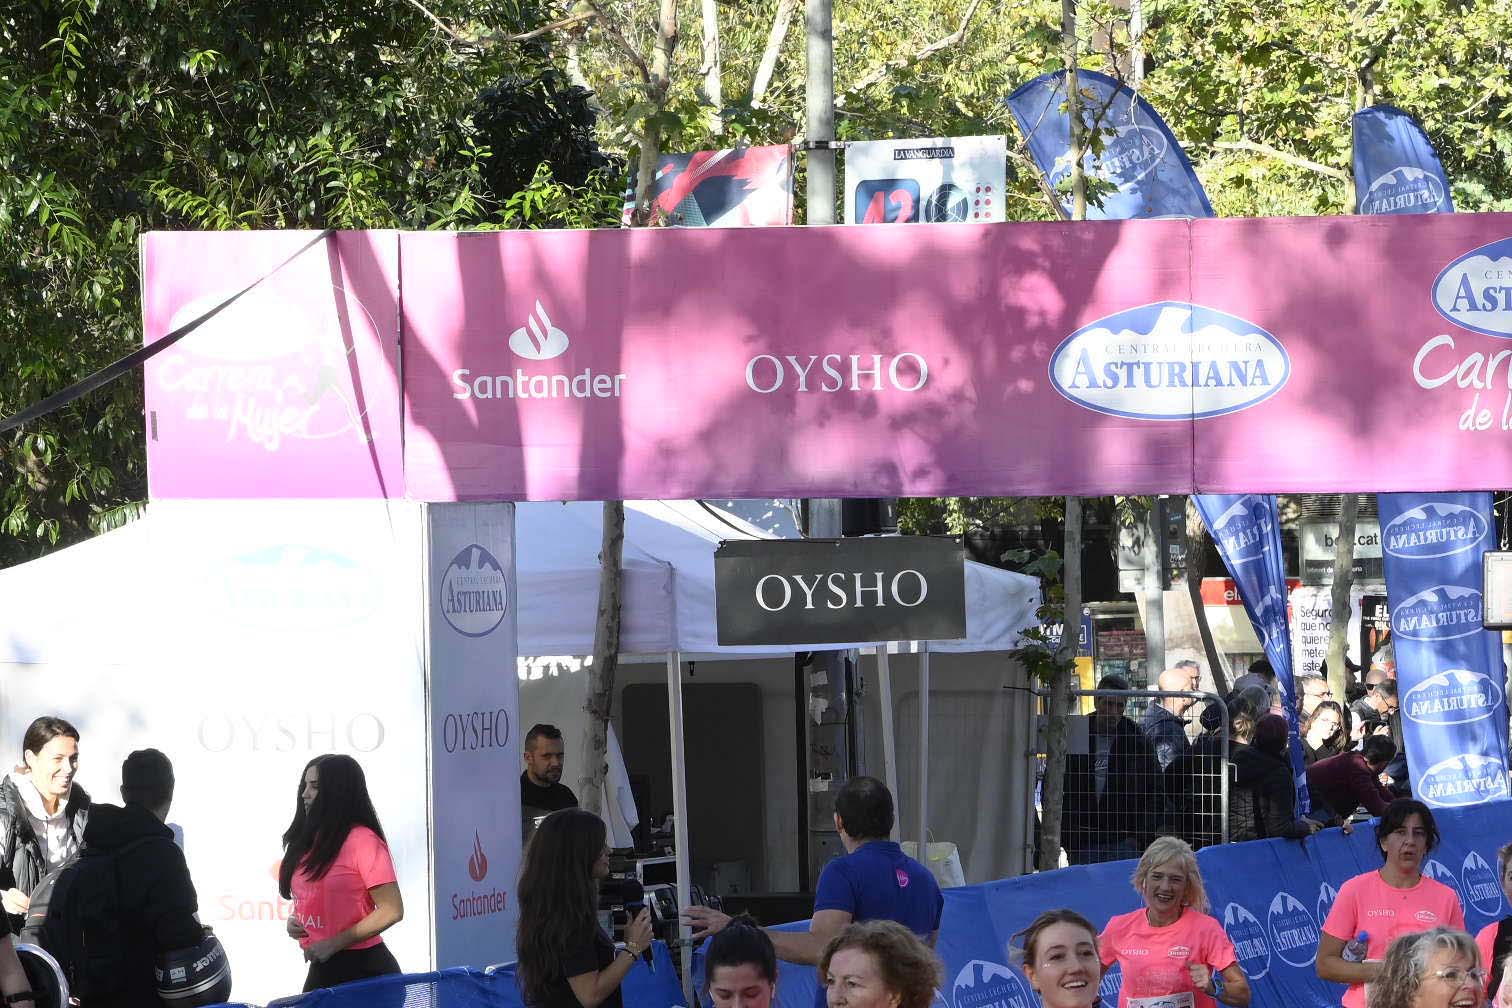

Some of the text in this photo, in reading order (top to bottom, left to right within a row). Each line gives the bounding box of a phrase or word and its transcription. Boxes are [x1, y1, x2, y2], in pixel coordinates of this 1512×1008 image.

[905, 147, 955, 160] VANGUARDIA
[453, 367, 627, 400] Santander
[745, 352, 929, 394] OYSHO
[1069, 346, 1272, 390] ASTURIANA
[1458, 394, 1493, 431] de
[1325, 533, 1379, 547] b.cat
[446, 583, 504, 614] ASTURIANA
[755, 570, 929, 612] OYSHO
[1300, 606, 1333, 620] Segur
[1303, 646, 1327, 658] mete
[197, 711, 386, 754] OYSHO
[442, 708, 509, 754] OYSHO
[451, 888, 507, 922] Santander
